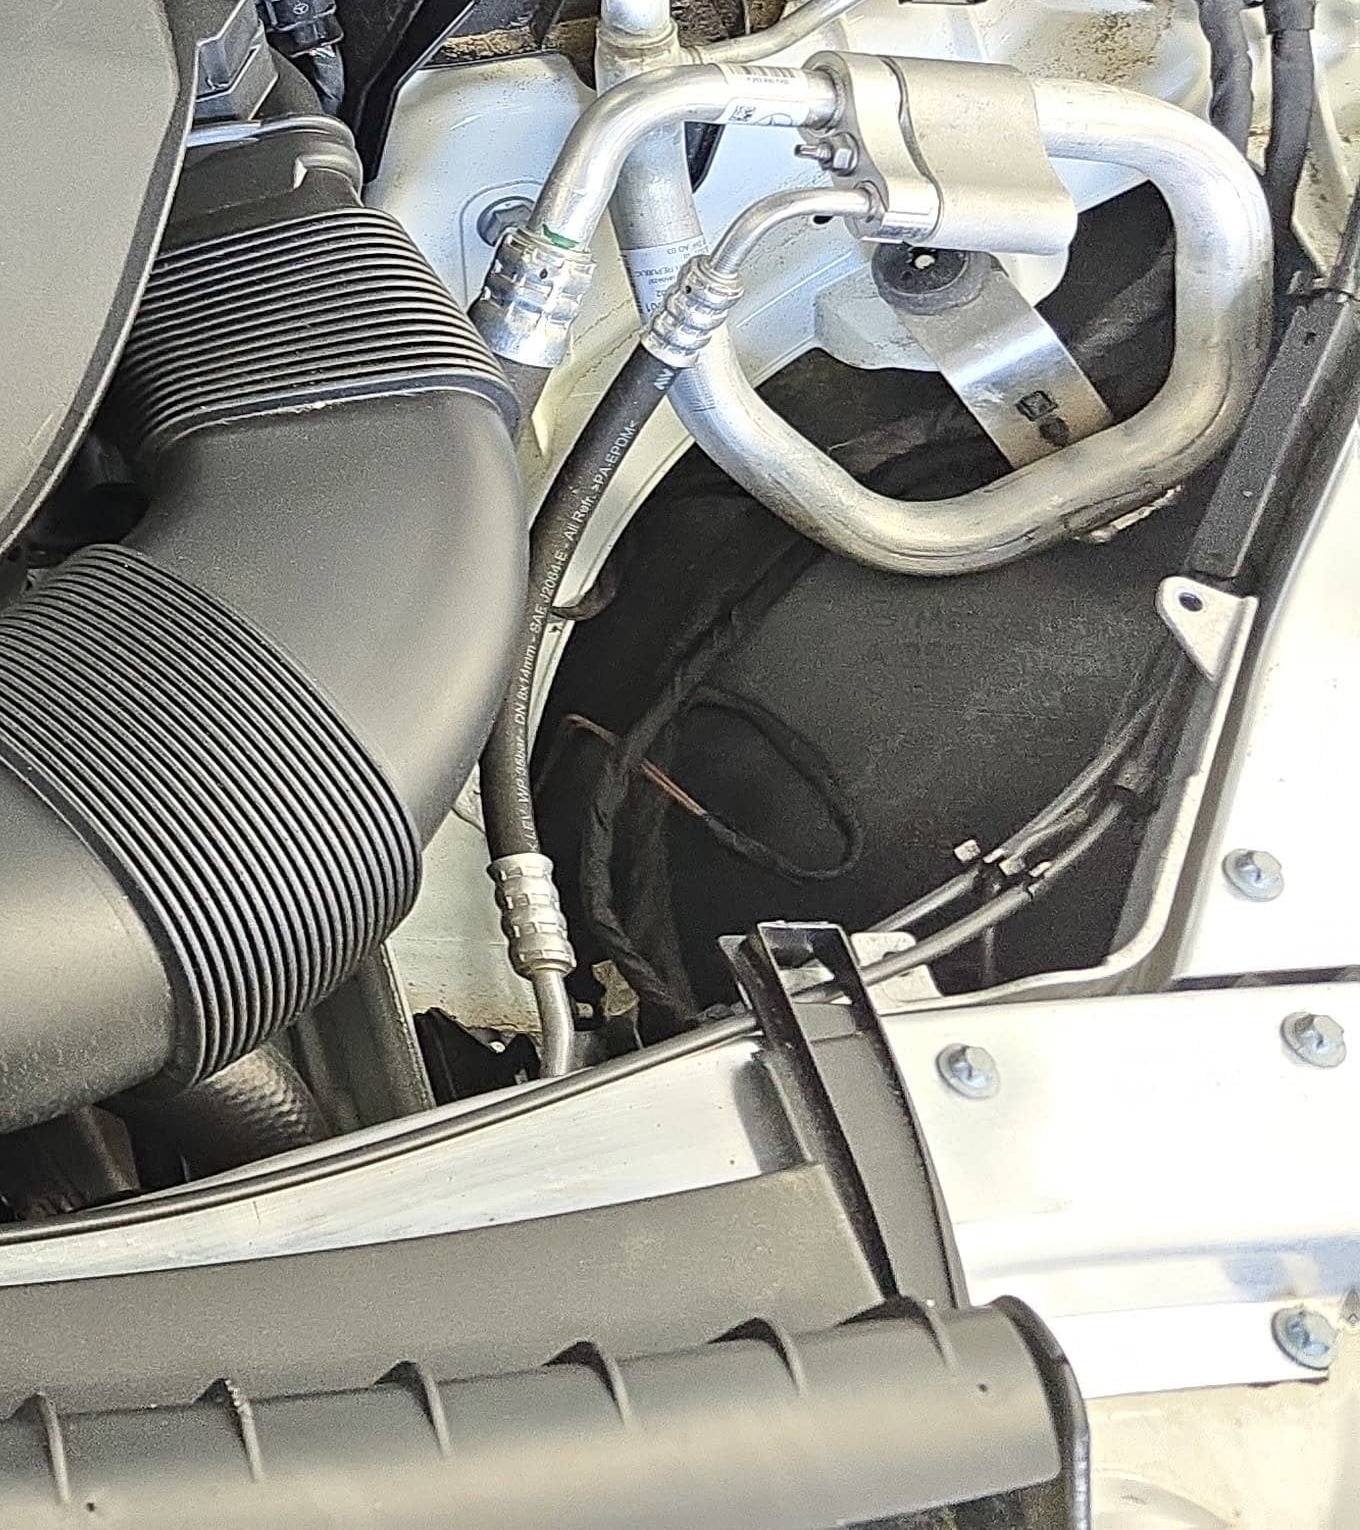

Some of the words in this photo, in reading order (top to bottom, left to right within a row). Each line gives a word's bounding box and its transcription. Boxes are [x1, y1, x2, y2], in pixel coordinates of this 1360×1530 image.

[513, 702, 527, 724] DN
[527, 601, 548, 634] SAE
[563, 523, 581, 542] All
